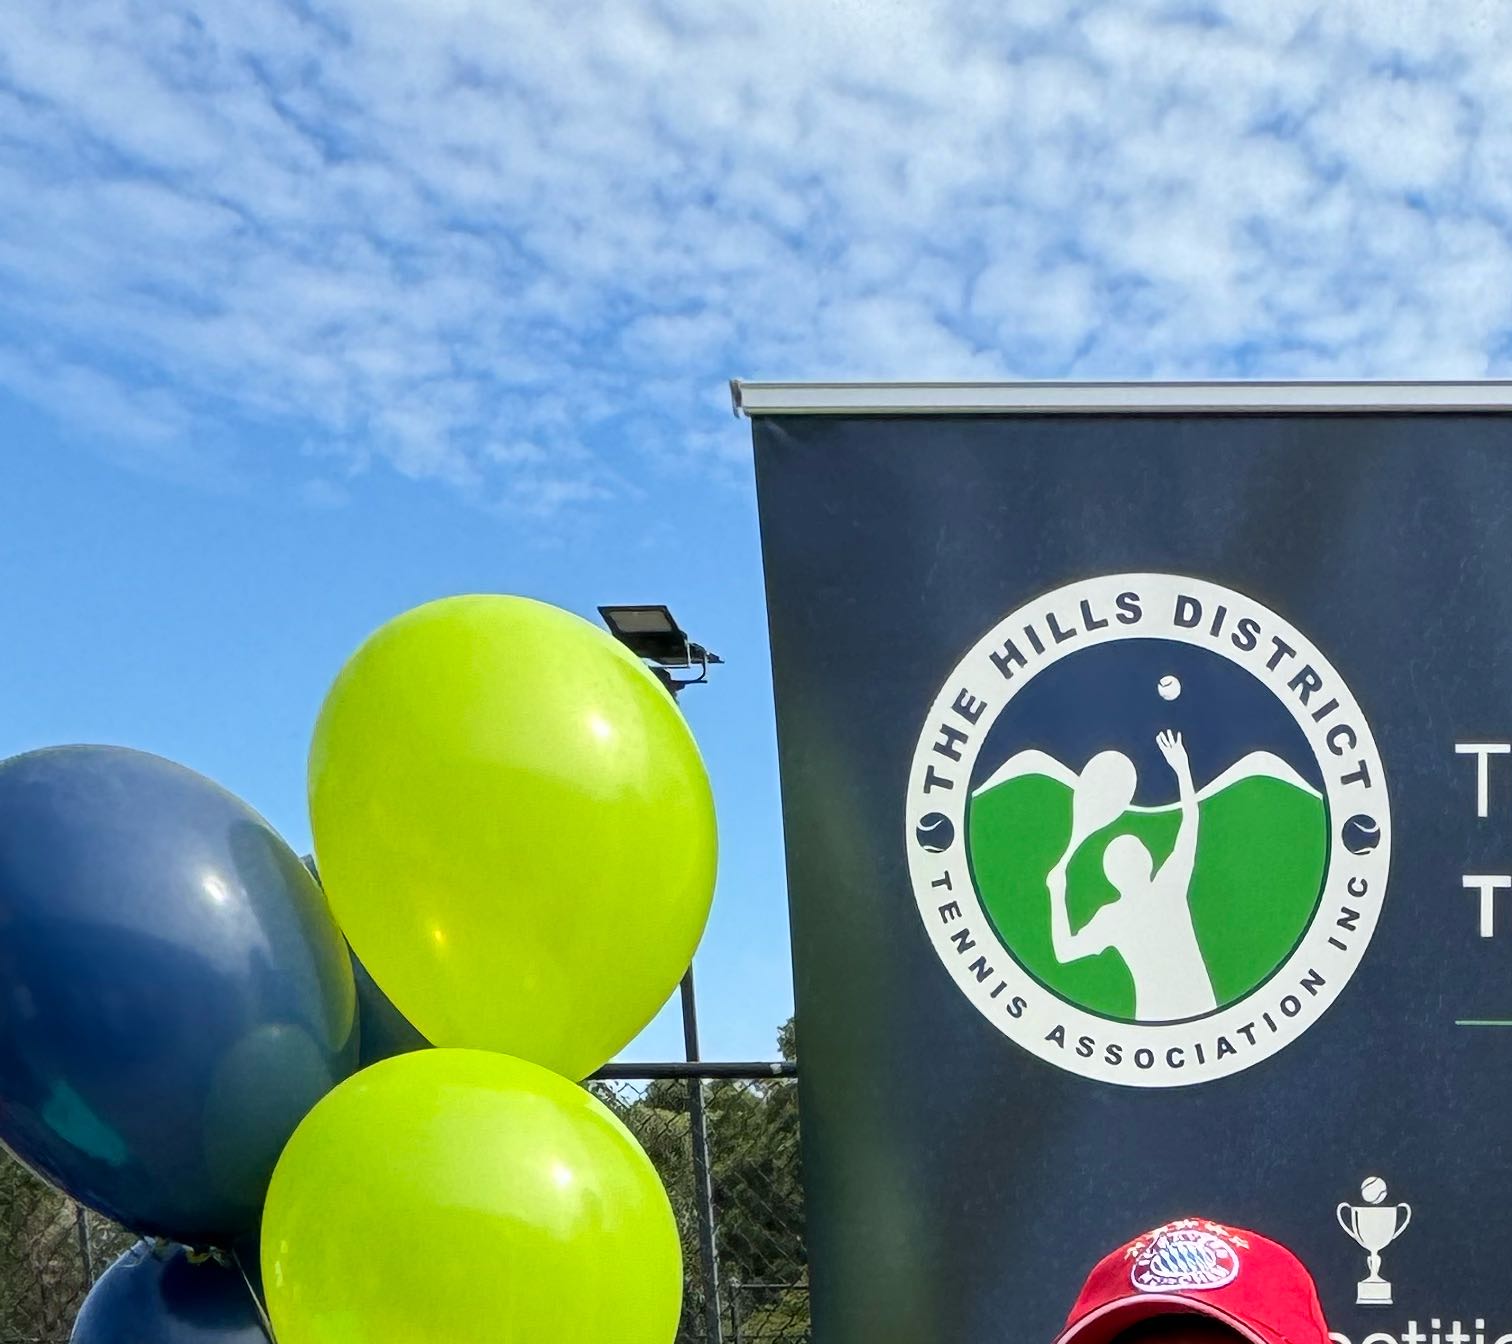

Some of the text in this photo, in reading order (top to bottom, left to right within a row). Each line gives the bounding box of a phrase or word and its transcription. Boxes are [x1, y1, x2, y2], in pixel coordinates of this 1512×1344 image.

[923, 591, 1372, 796] THE HILLS DISTRICT
[930, 871, 1369, 1070] TENNIS ASSOCIATION INC
